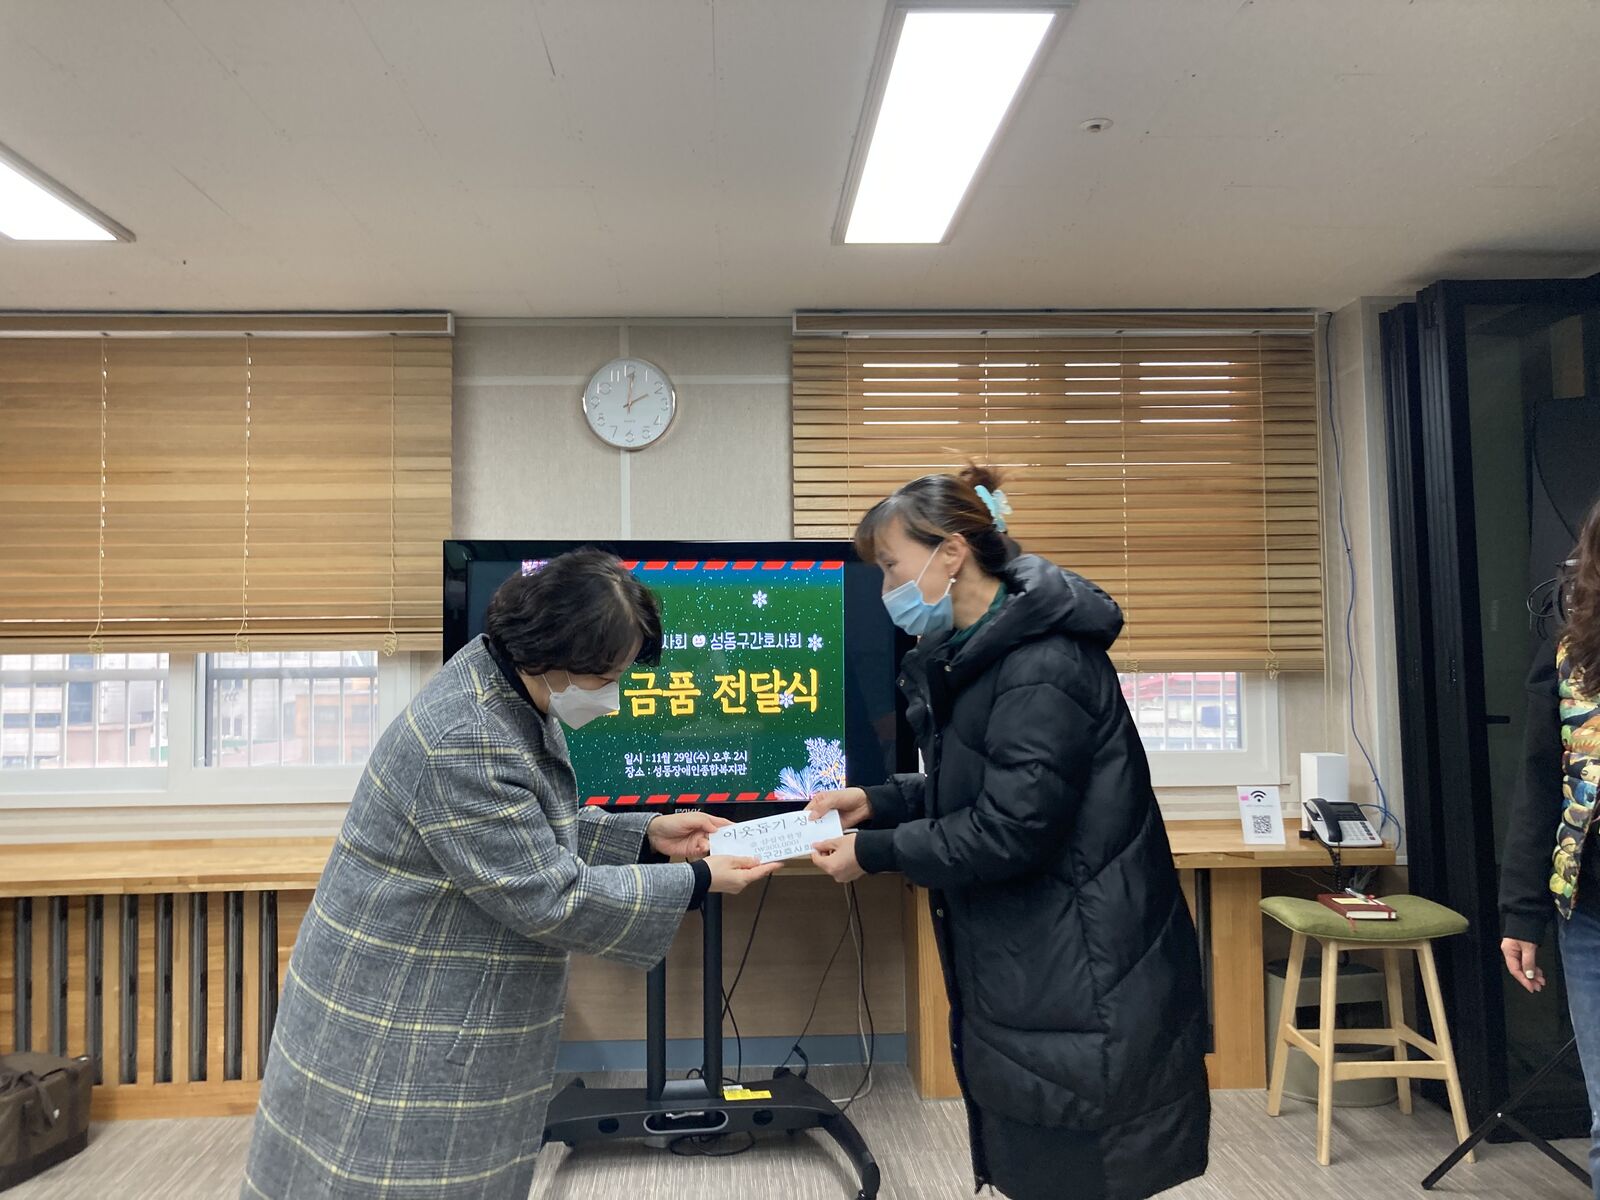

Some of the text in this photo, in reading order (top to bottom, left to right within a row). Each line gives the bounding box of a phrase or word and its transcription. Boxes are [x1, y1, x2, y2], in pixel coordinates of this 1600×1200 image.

[596, 382, 612, 395] 10
[654, 381, 664, 395] 2
[590, 396, 600, 410] 9
[660, 398, 669, 411] 3
[597, 413, 606, 426] 8
[610, 425, 618, 439] 7
[624, 429, 635, 442] 6
[710, 631, 802, 650] 성동구간호사회
[605, 668, 818, 717] 금품 전달식
[624, 752, 643, 765] 일시
[652, 751, 671, 765] 11월
[673, 750, 710, 764] 29일(수)
[712, 750, 731, 763] 오후
[733, 749, 748, 763] 2시
[625, 765, 645, 778] 장소
[652, 762, 748, 778] 성동장애인종합복지관
[757, 843, 813, 860] 구간호사회
